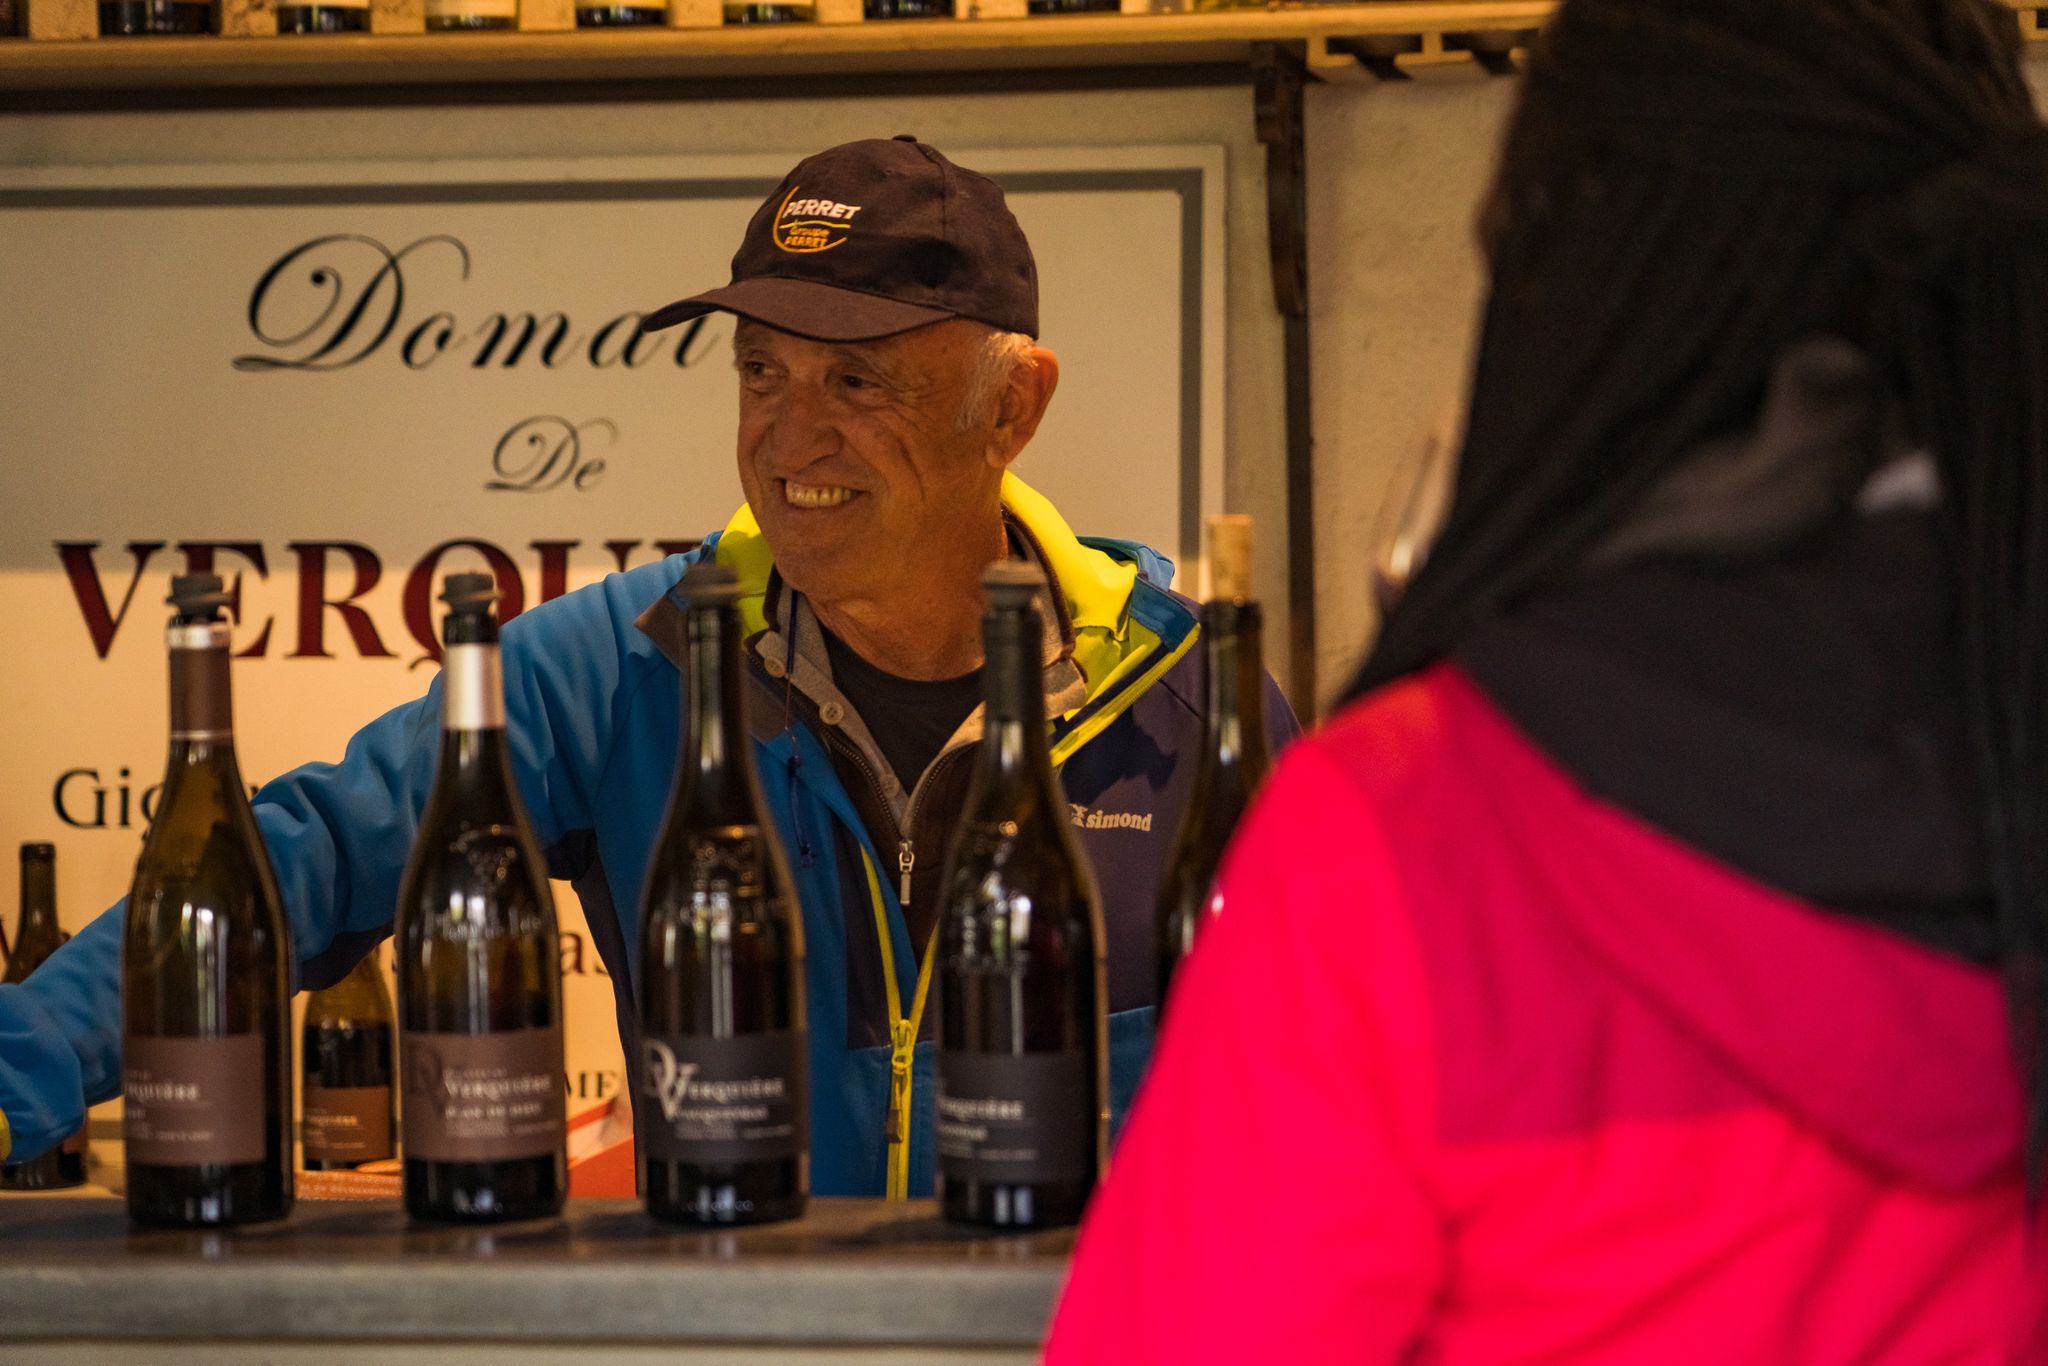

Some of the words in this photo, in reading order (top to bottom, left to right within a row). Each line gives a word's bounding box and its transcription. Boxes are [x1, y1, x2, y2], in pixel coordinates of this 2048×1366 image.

[782, 199, 862, 219] PERRET
[484, 414, 620, 492] De
[1085, 810, 1152, 832] simond
